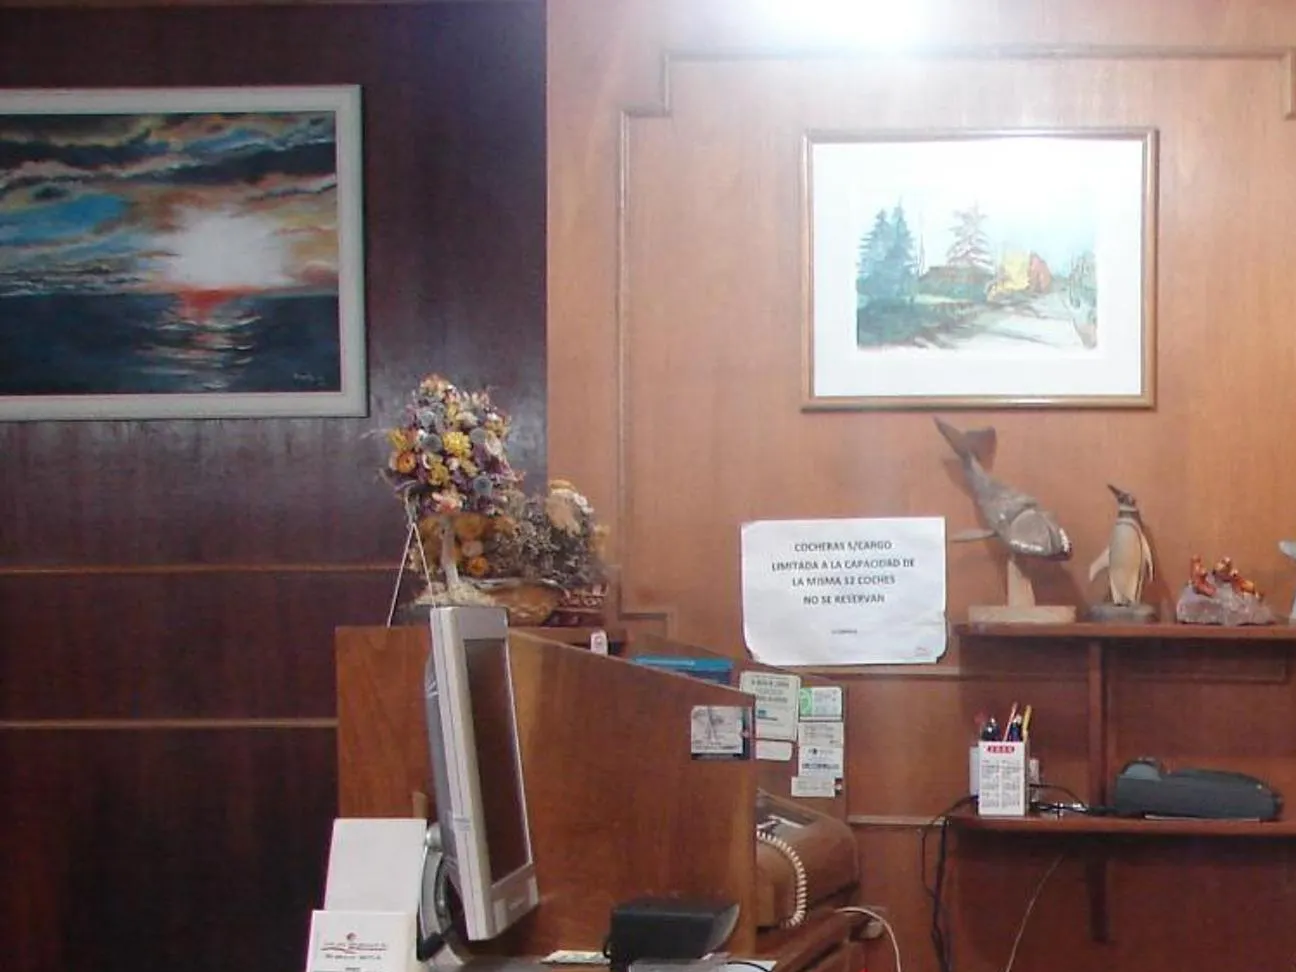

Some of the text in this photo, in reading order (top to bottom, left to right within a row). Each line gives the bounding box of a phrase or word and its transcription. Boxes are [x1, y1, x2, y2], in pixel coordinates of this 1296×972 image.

[794, 541, 893, 552] COCHERAS S/CARGO
[772, 558, 915, 572] LIMITADA A LA CAPACIDAD DE
[792, 577, 804, 587] LA
[806, 576, 842, 586] MISMA
[857, 575, 896, 585] COCHES
[803, 594, 885, 605] NO SE RESERVAN
